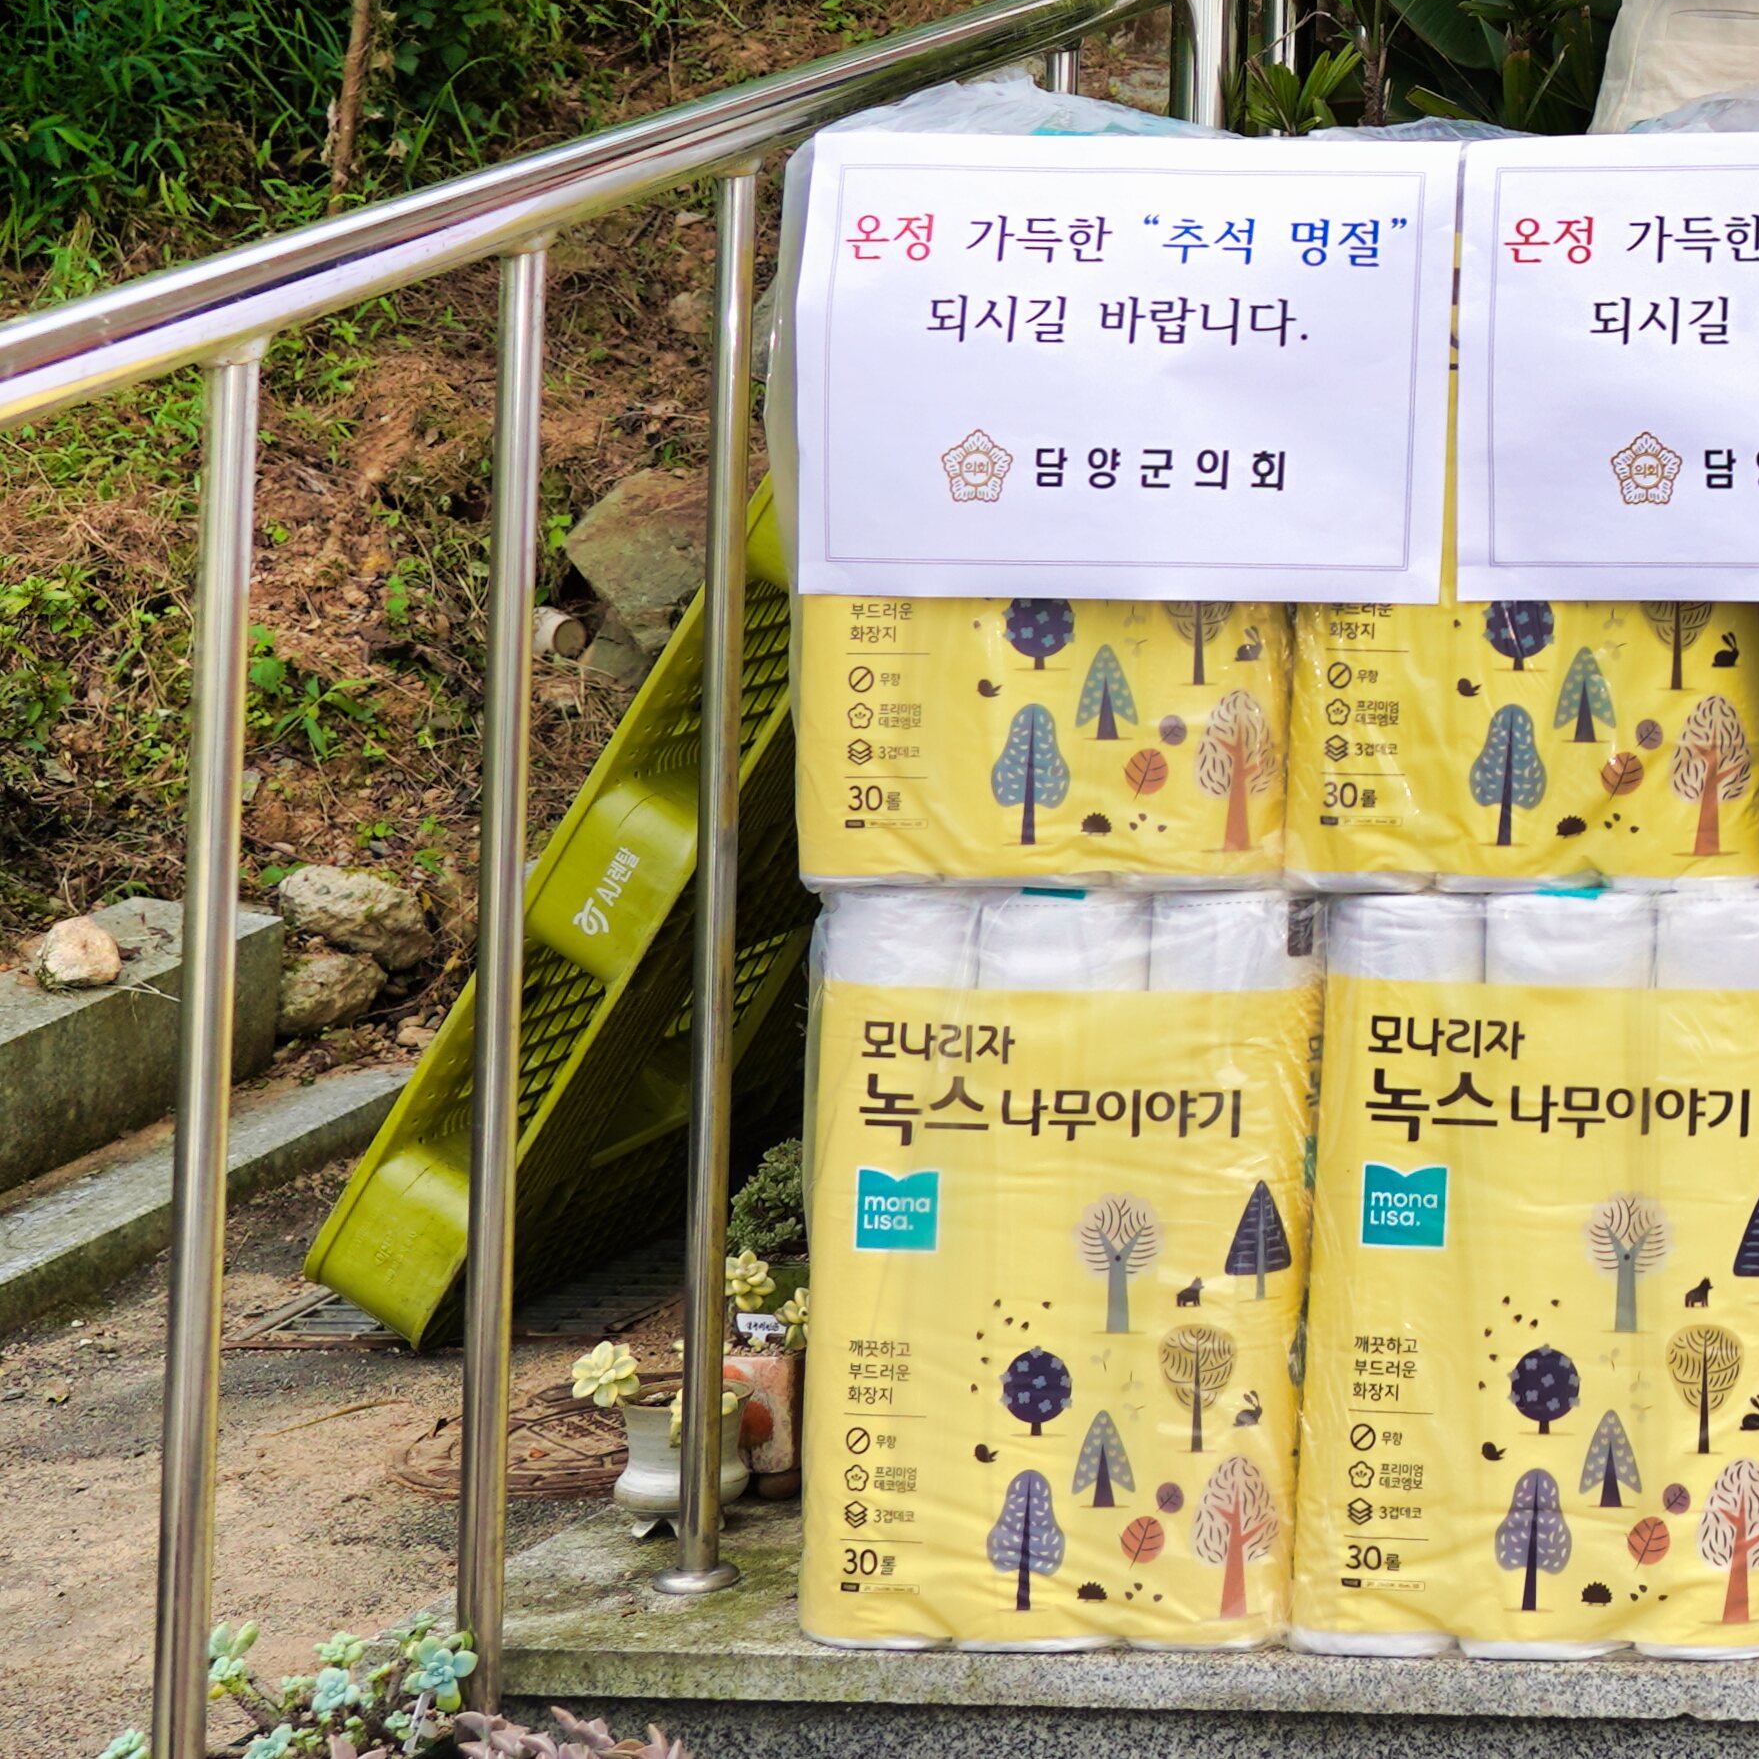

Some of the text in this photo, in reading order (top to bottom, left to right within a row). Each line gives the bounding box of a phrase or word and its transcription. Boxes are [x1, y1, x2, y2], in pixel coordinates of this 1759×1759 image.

[846, 213, 1406, 268] 온정 가득한 “추석 명절”
[1503, 215, 1594, 264] 온정
[926, 294, 1309, 349] 되시길 바랍니다.
[1590, 295, 1730, 347] 되시길
[964, 461, 989, 476] 의회
[1036, 446, 1287, 491] 담양군의회
[596, 847, 640, 907] AJ렌탈
[862, 1021, 1015, 1064] 모나리자
[1368, 1015, 1525, 1059] 모나리자
[860, 1074, 1241, 1145] 녹스 나무이야기
[1366, 1068, 1751, 1141] 녹스 나무이야기
[1371, 1191, 1438, 1208] mona
[1354, 1336, 1418, 1354] 깨끗하고
[1354, 1359, 1418, 1379] 부드러운
[1353, 1382, 1399, 1401] 화장지
[1382, 1431, 1402, 1446] 무향
[1380, 1463, 1424, 1477] 프리미엄
